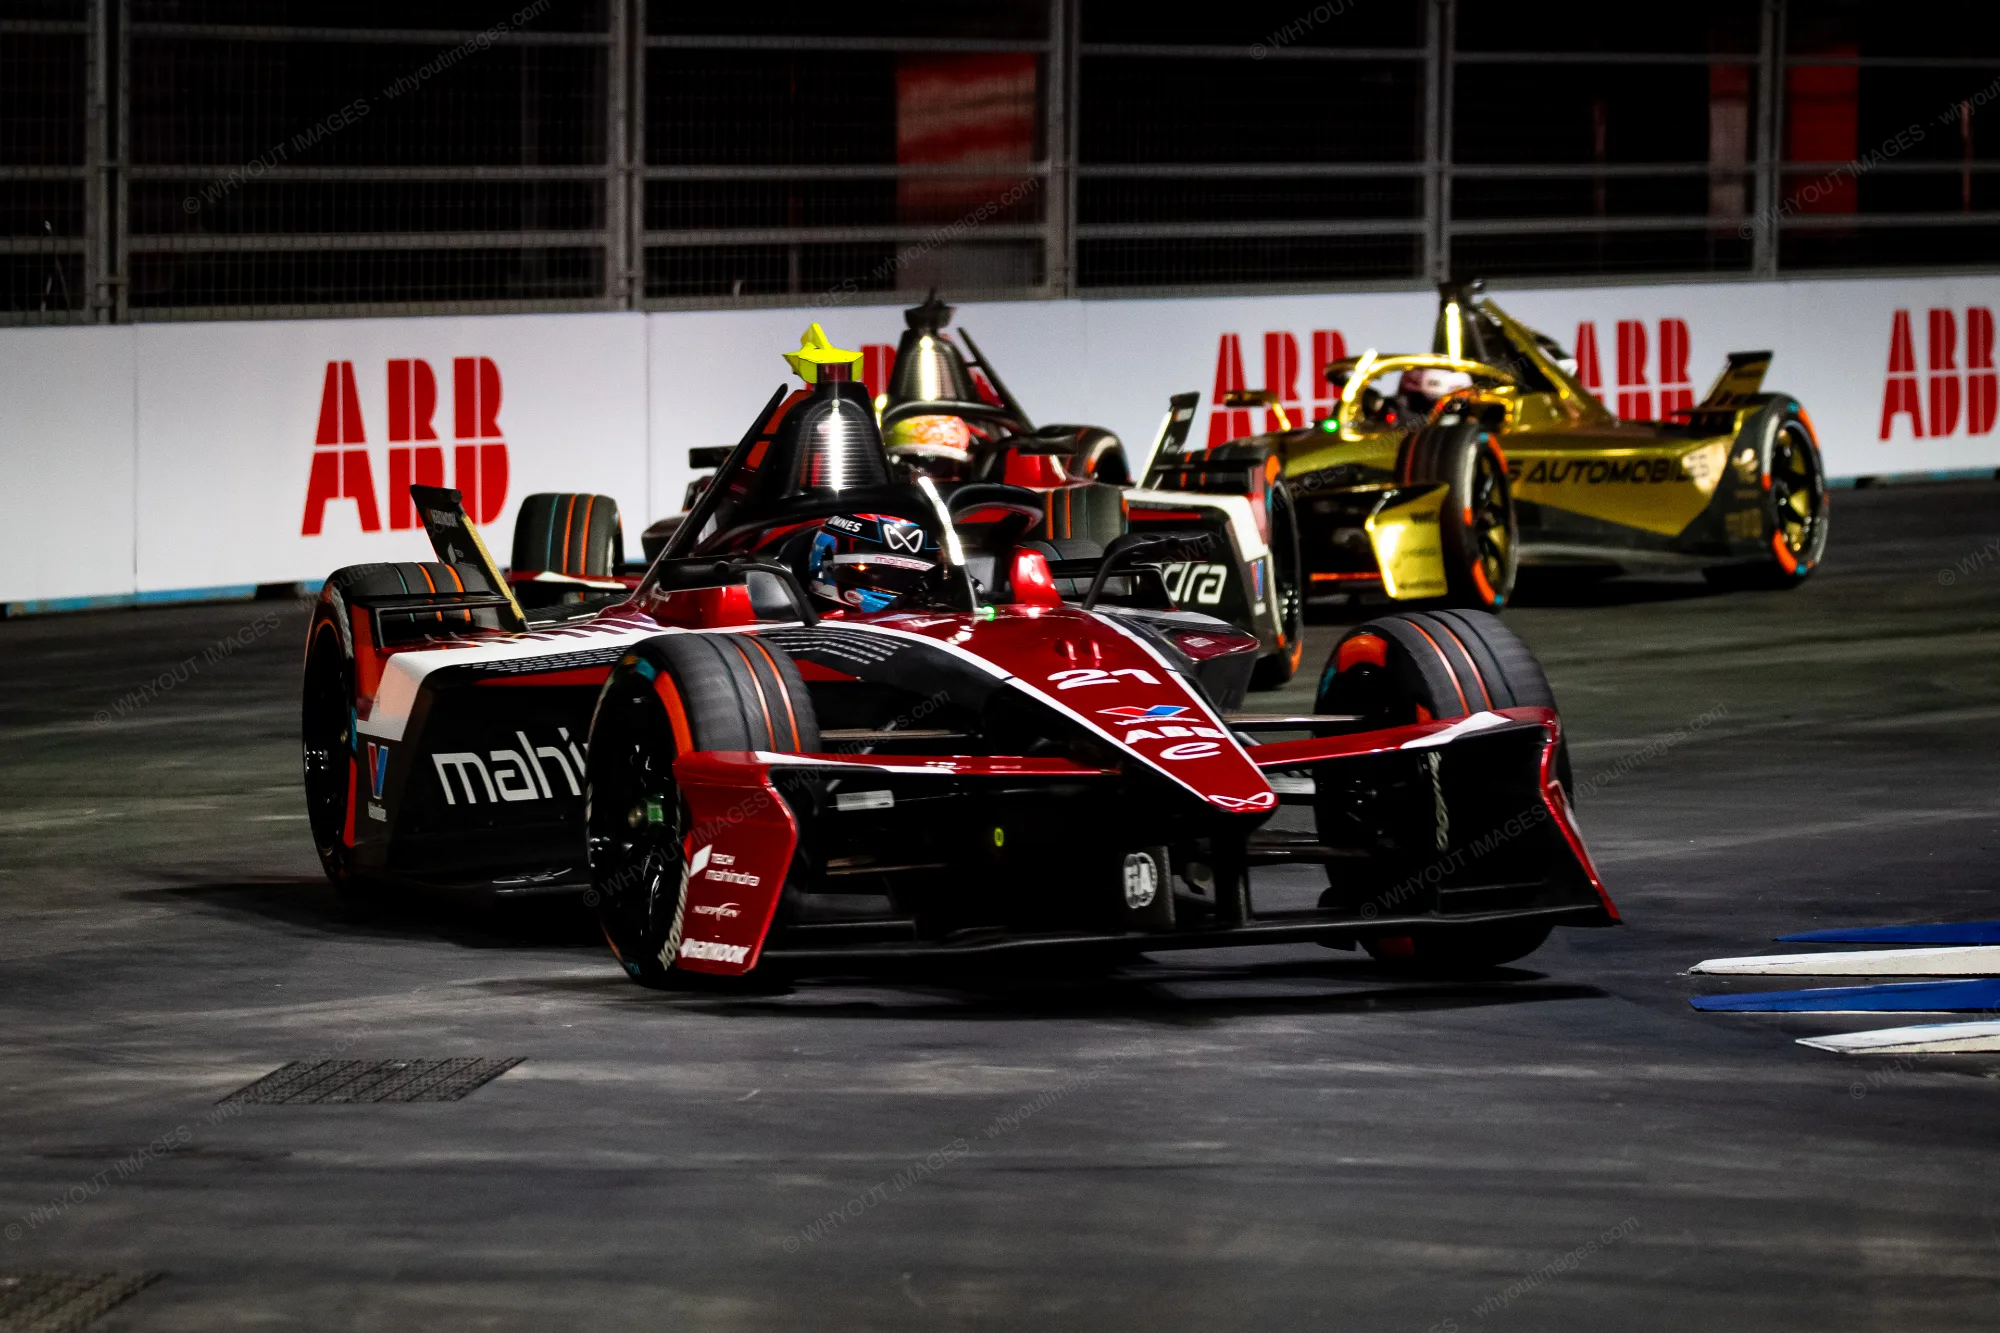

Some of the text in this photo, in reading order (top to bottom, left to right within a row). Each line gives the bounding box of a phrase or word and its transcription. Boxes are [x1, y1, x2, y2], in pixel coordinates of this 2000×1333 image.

[1576, 318, 1694, 425] ABB
[1879, 309, 1997, 439] ABB
[302, 356, 508, 536] ABB
[431, 727, 589, 806] mahi
